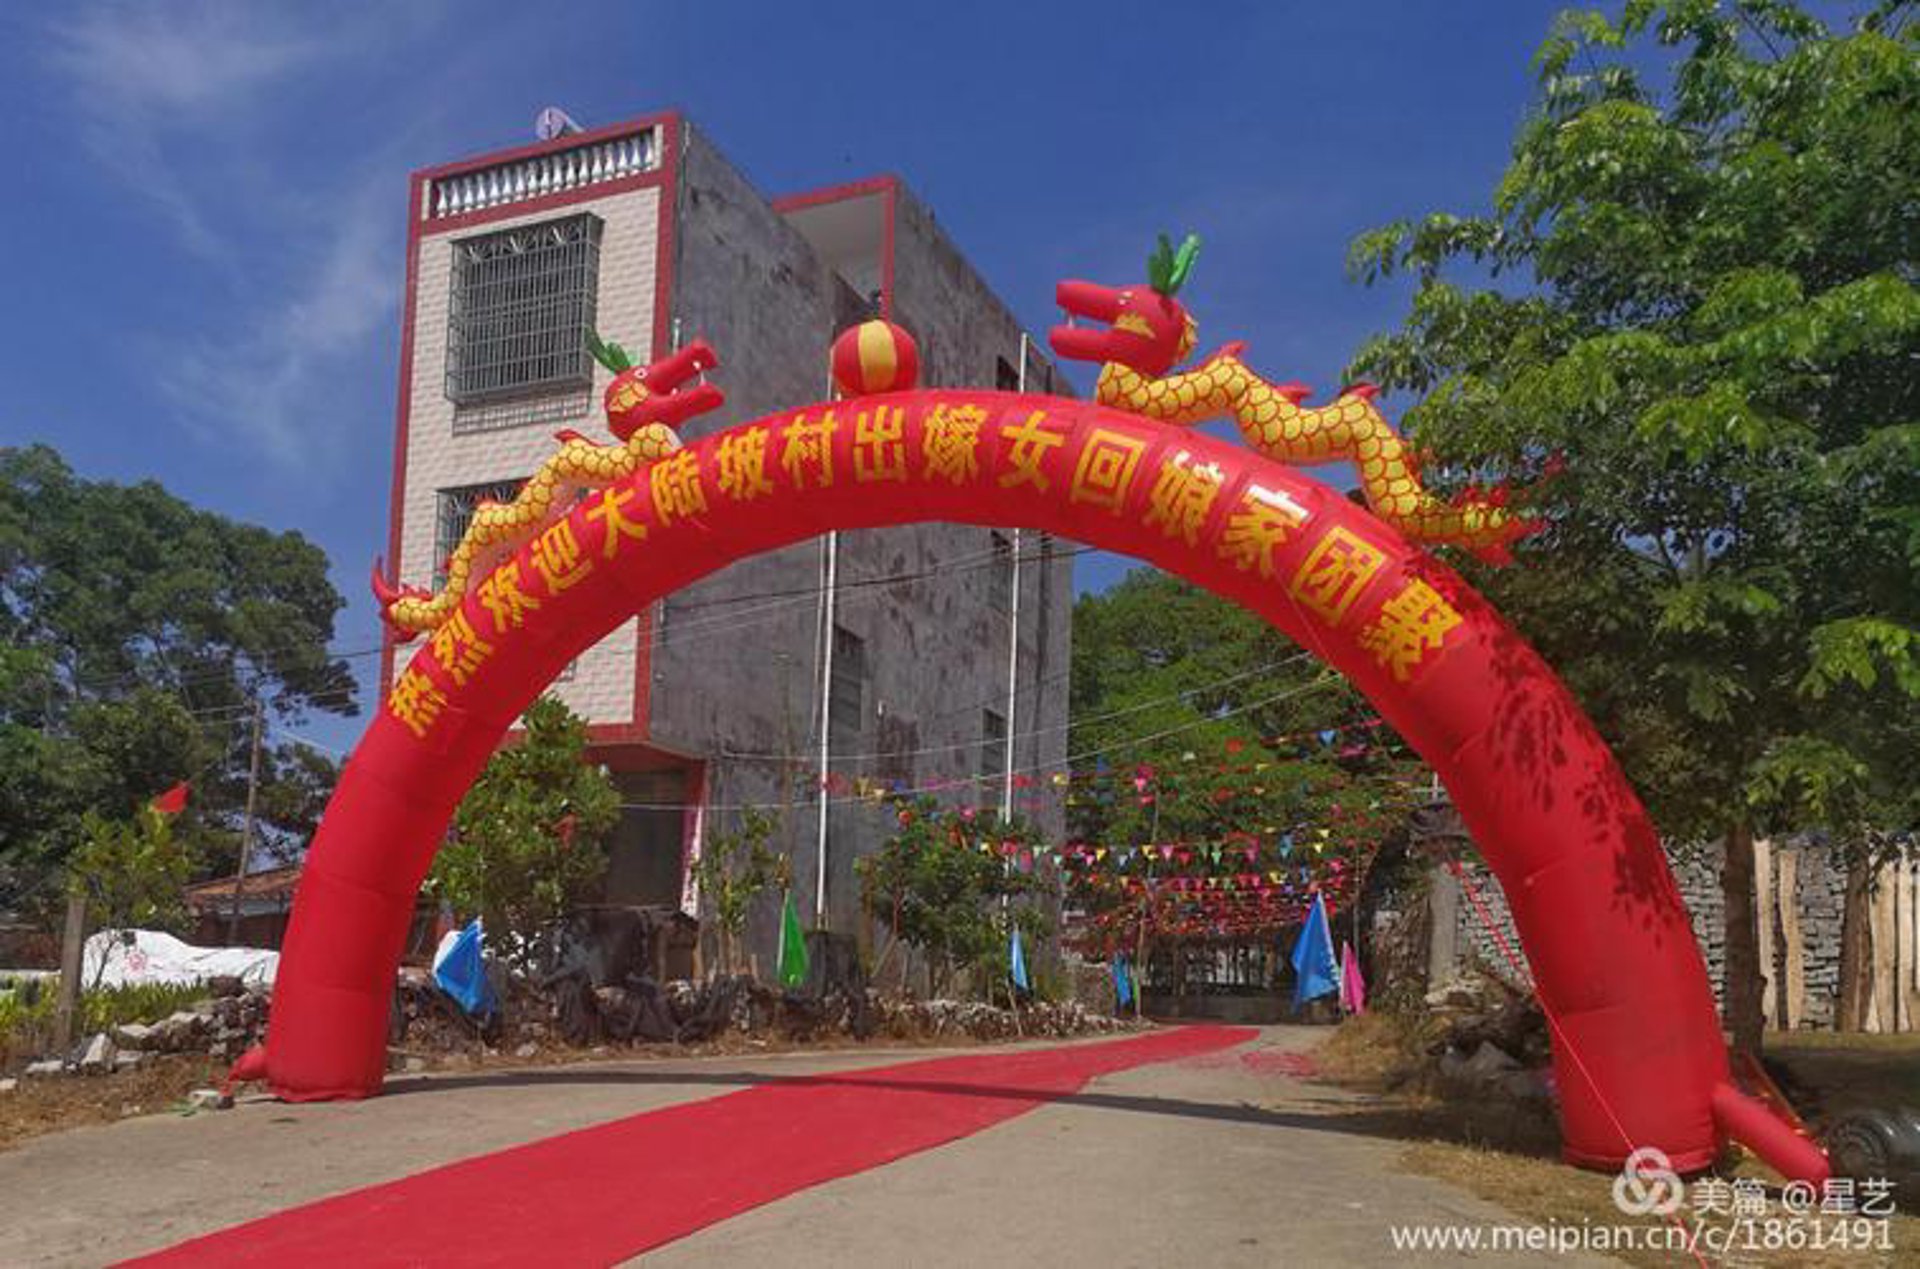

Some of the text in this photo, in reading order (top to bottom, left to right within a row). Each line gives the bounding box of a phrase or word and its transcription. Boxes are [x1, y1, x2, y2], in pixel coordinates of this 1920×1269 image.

[389, 402, 1463, 735] 热烈欢迎大陆坡村出嫁女回娘家团聚
